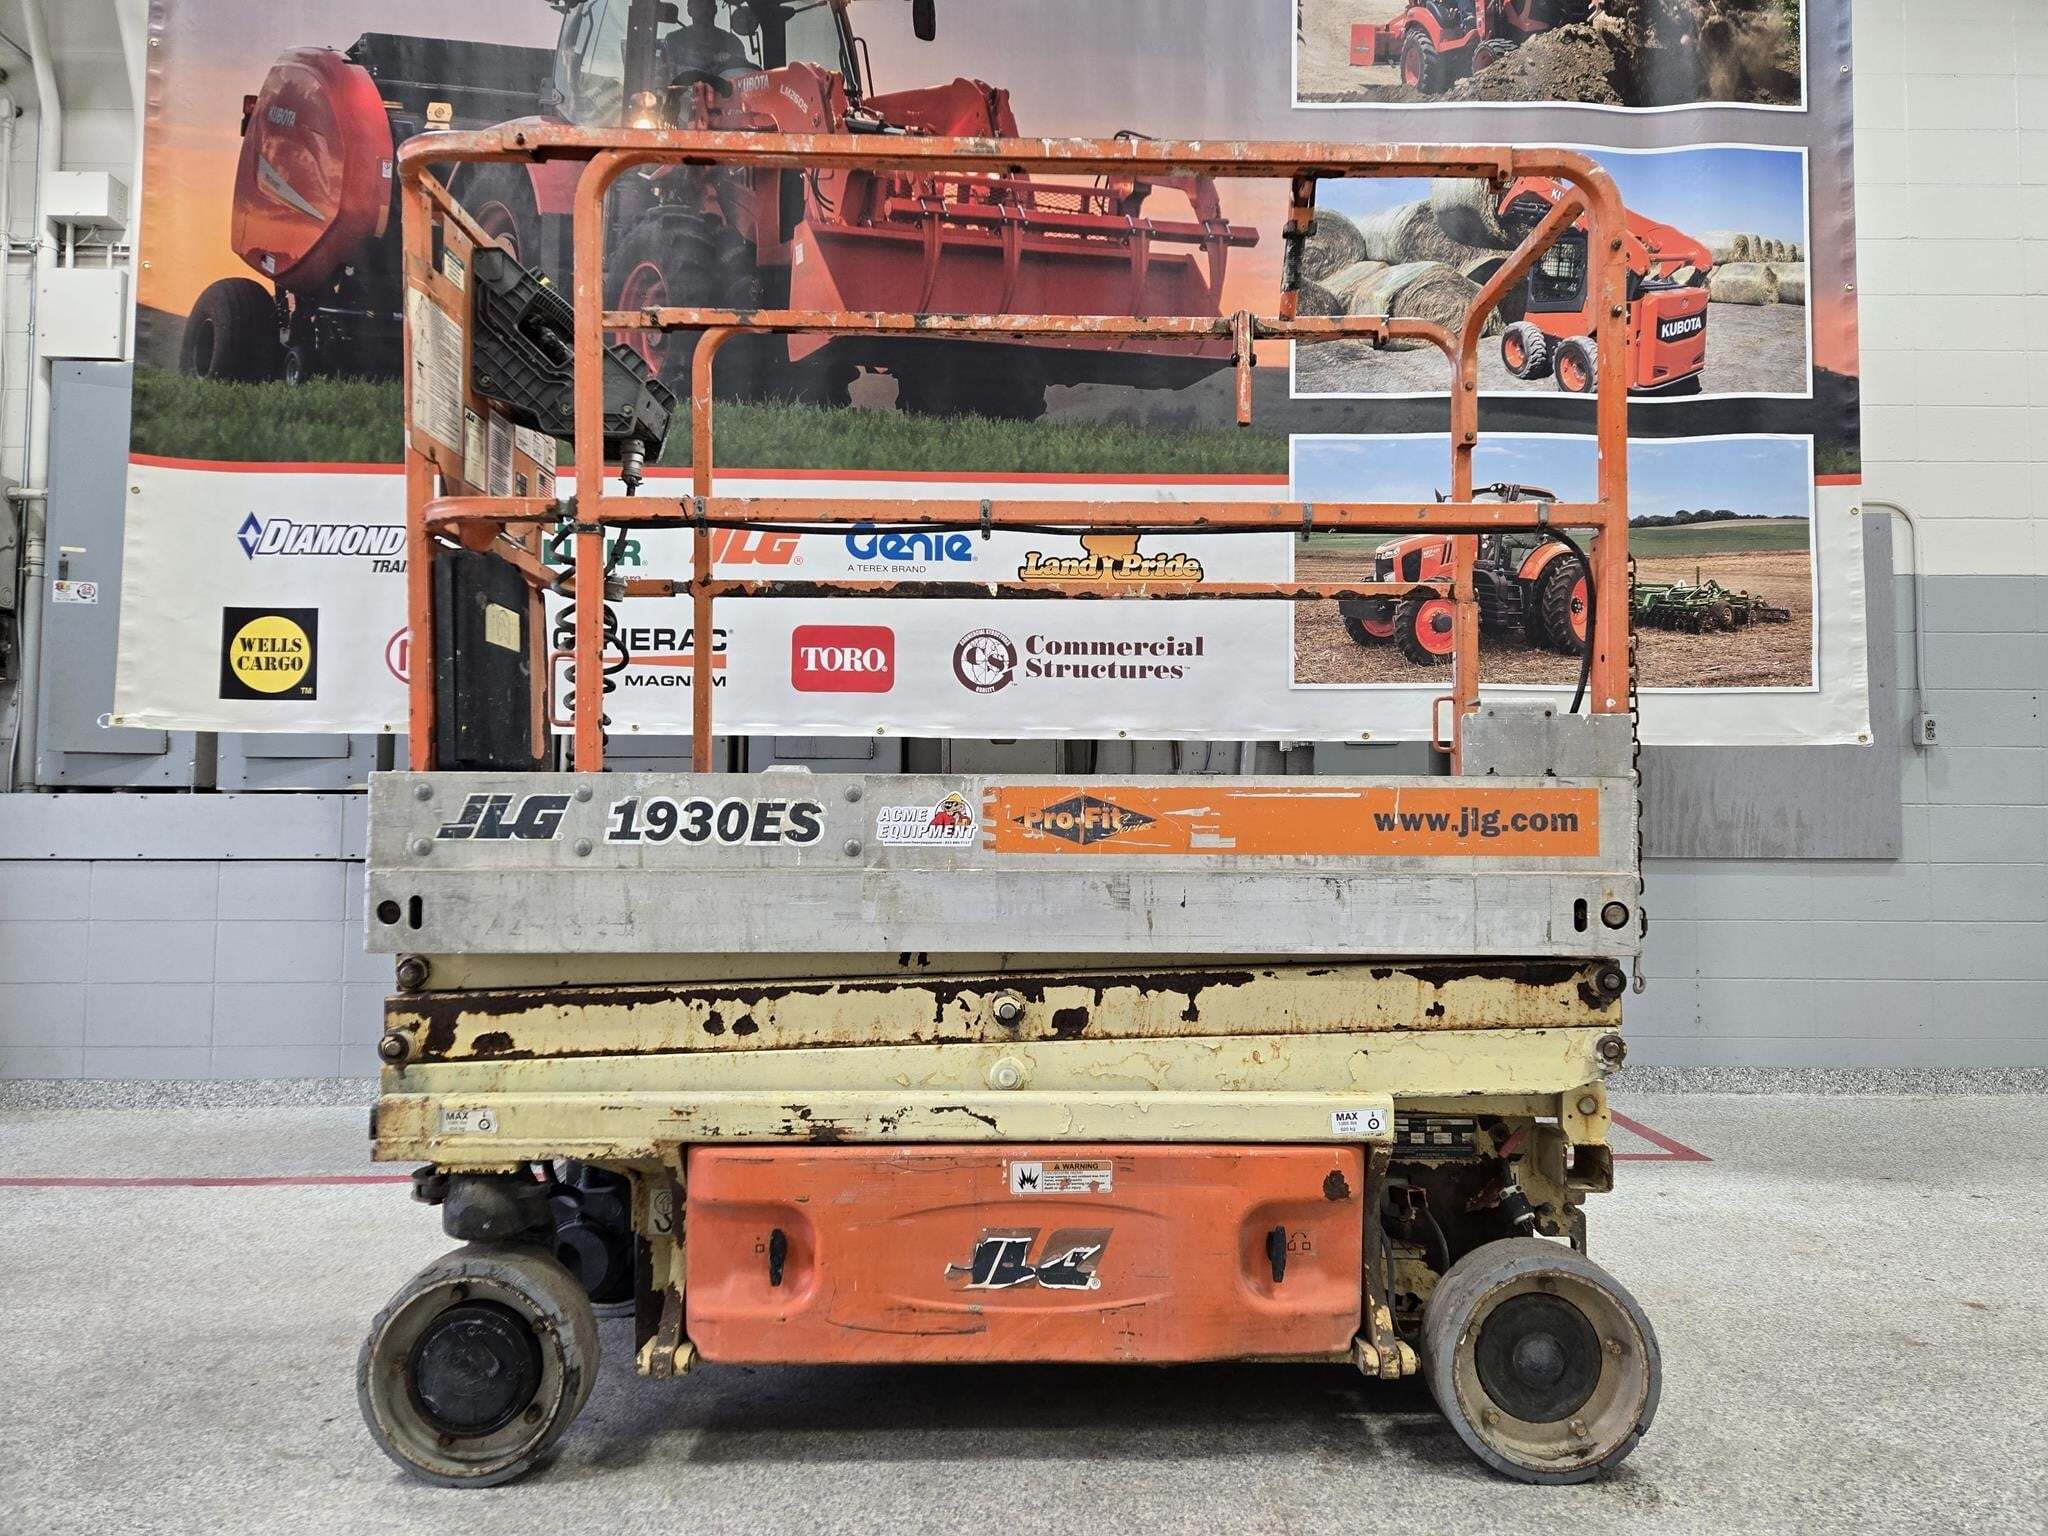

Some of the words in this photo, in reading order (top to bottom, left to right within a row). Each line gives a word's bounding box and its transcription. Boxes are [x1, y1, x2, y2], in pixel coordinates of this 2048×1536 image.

[737, 74, 769, 92] KUBOTA
[268, 105, 297, 129] KUBOTA
[1661, 316, 1702, 339] KUBOTA
[255, 518, 407, 556] DIAMOND
[372, 560, 408, 573] TRAI
[847, 564, 855, 572] A
[857, 564, 889, 573] TEREX
[891, 565, 927, 573] BRAND
[1024, 552, 1099, 577] Land
[1119, 552, 1201, 578] Pride
[239, 637, 302, 653] WELLS
[552, 628, 727, 651] GNERAC
[1025, 634, 1204, 656] Commercial
[236, 656, 304, 671] CARGO
[800, 646, 886, 672] TORO
[1025, 657, 1184, 679] Structures
[624, 675, 727, 687] MAGNM
[434, 793, 573, 840] JLG
[603, 798, 825, 844] 1930ES
[879, 807, 929, 822] ACME
[1373, 806, 1579, 838] www.jlg.com
[878, 824, 977, 839] EQUIPMENT
[445, 1111, 469, 1121] MAX
[1335, 1111, 1359, 1121] MAX
[1062, 1162, 1099, 1170] WARNING
